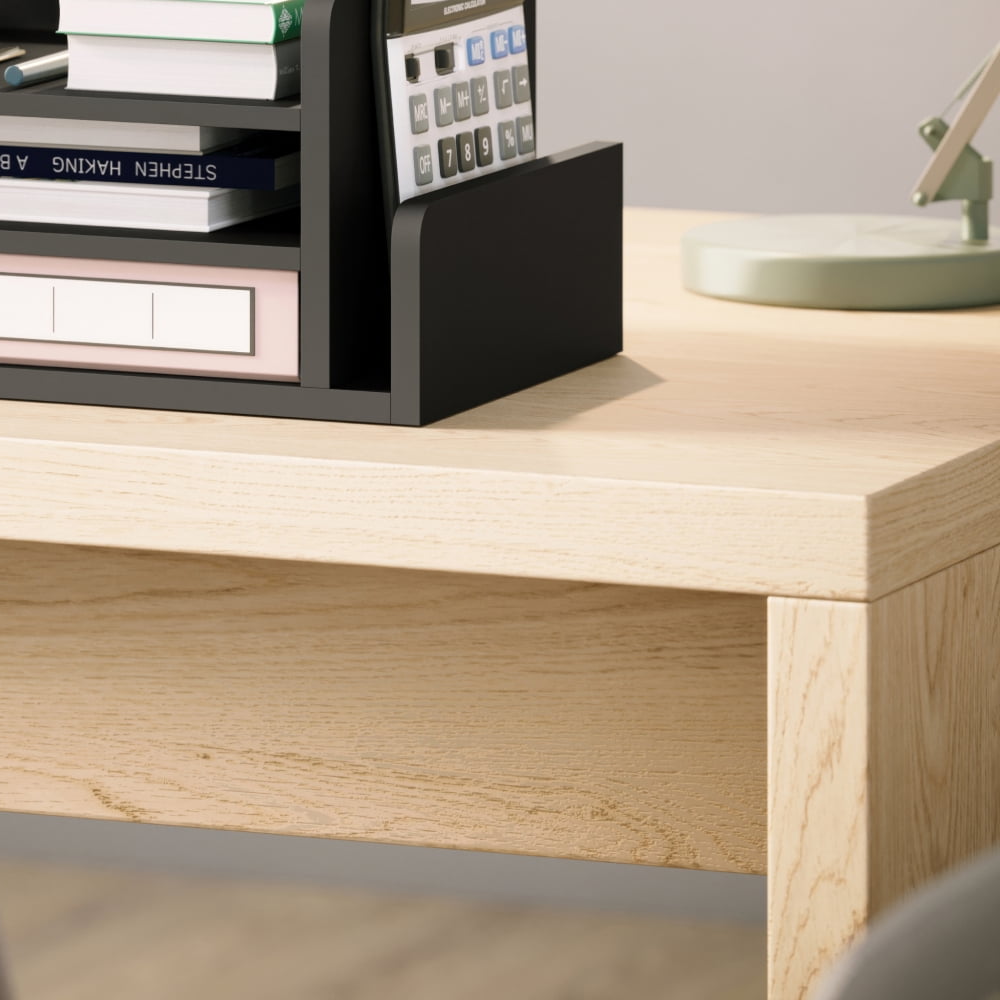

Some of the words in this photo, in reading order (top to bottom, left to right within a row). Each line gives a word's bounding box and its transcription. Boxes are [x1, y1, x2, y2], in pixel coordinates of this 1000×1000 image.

[414, 102, 428, 122] MRC
[464, 143, 472, 162] 8
[482, 136, 489, 156] 9
[16, 155, 29, 171] A
[52, 156, 121, 176] HAKING
[420, 153, 431, 175] OFF
[446, 148, 452, 168] 7
[134, 160, 217, 181] STEPHEN
